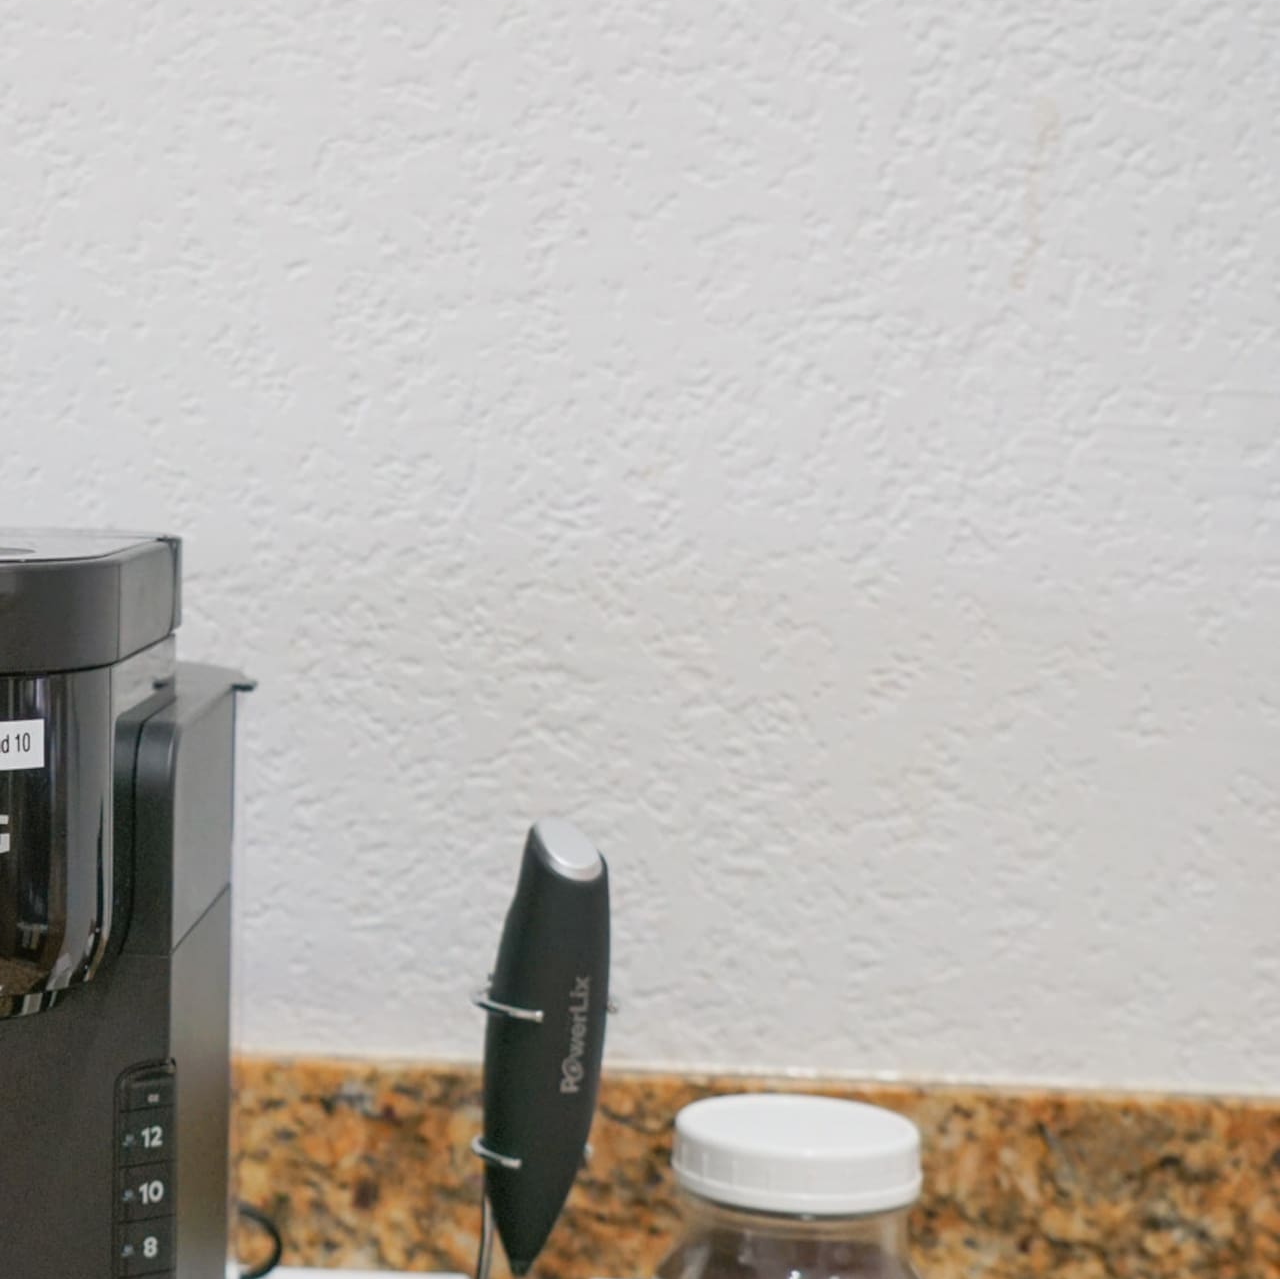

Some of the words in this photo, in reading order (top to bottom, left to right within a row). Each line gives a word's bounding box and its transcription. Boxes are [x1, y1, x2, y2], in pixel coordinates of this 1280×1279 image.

[15, 732, 31, 753] 10
[140, 1125, 163, 1149] 12
[138, 1180, 164, 1205] 10
[143, 1235, 158, 1259] 8
